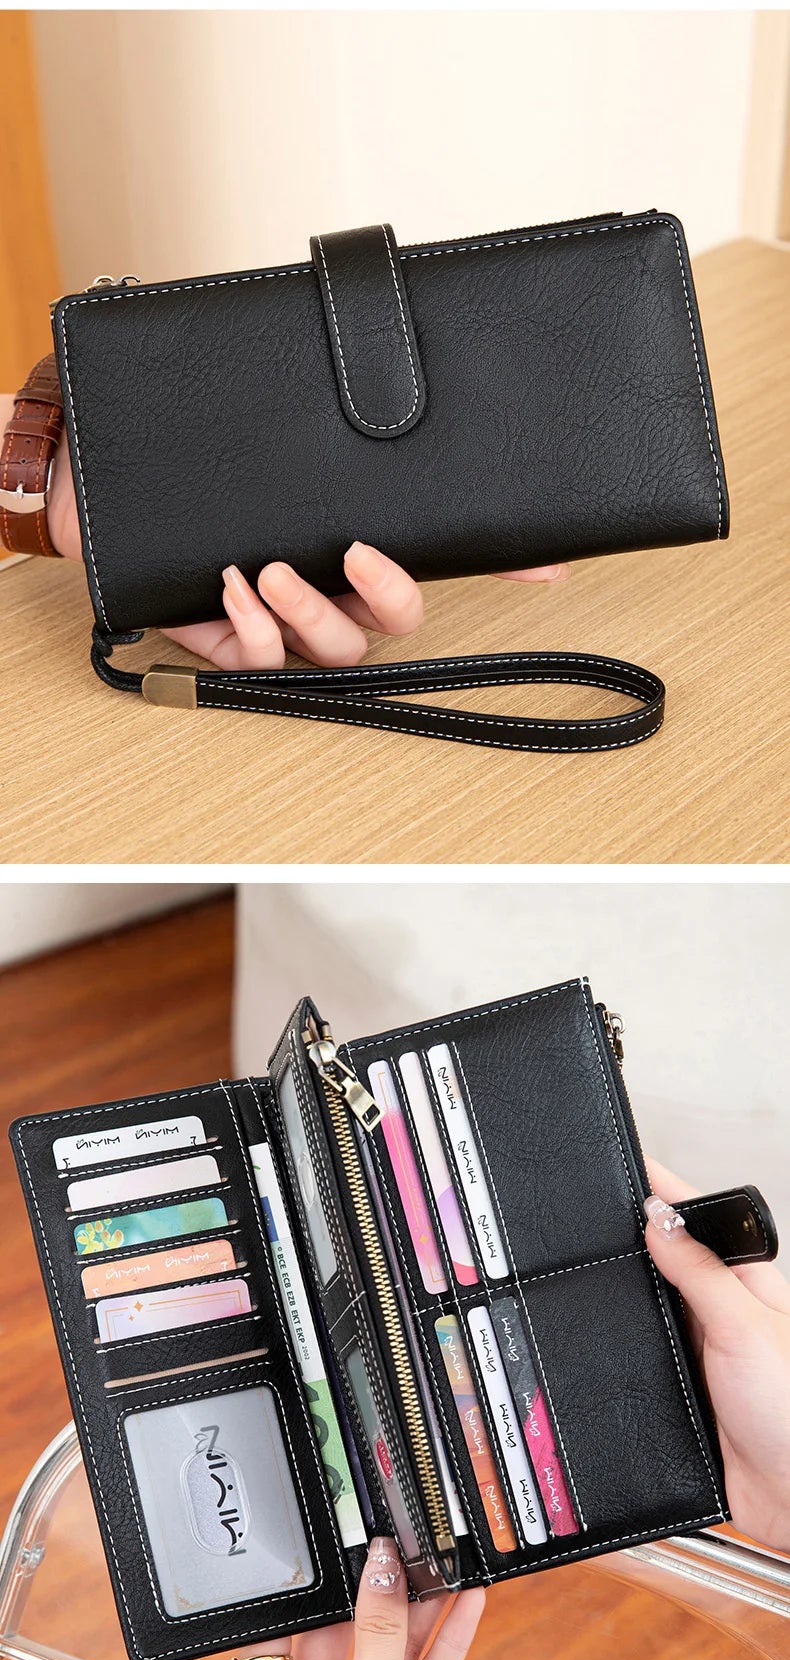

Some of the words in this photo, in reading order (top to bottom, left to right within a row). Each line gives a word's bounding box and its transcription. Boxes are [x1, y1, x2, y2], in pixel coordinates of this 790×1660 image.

[277, 1254, 287, 1269] BCE
[281, 1272, 292, 1288] ECB
[286, 1291, 296, 1306] EZB
[291, 1309, 301, 1325] EKT
[295, 1327, 306, 1343] EKP
[301, 1345, 310, 1360] 2002
